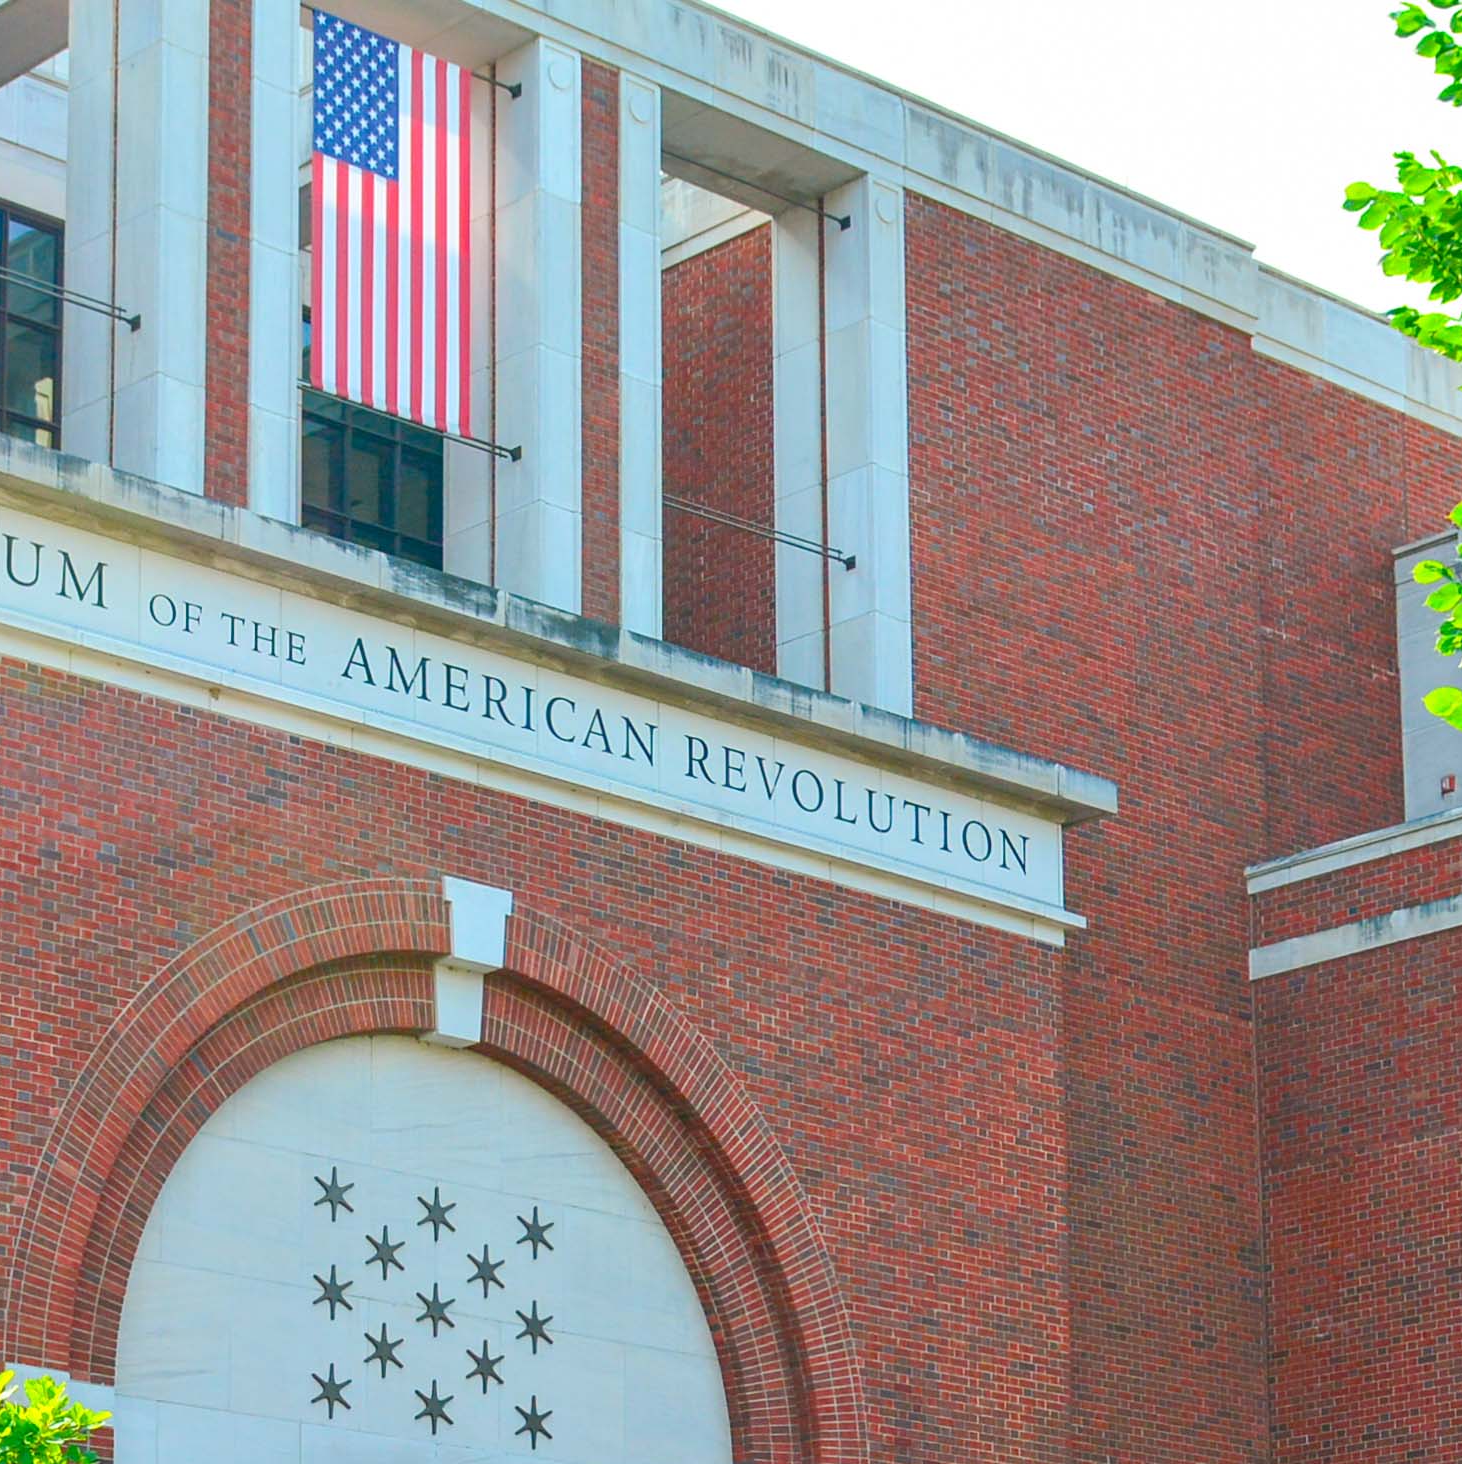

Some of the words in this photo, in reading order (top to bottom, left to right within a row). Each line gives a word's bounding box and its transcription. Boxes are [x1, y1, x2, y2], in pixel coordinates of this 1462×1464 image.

[149, 593, 203, 634] OF
[220, 612, 307, 666] THE
[341, 637, 659, 768] AMERICAN
[683, 735, 1031, 876] REVOLUTION
